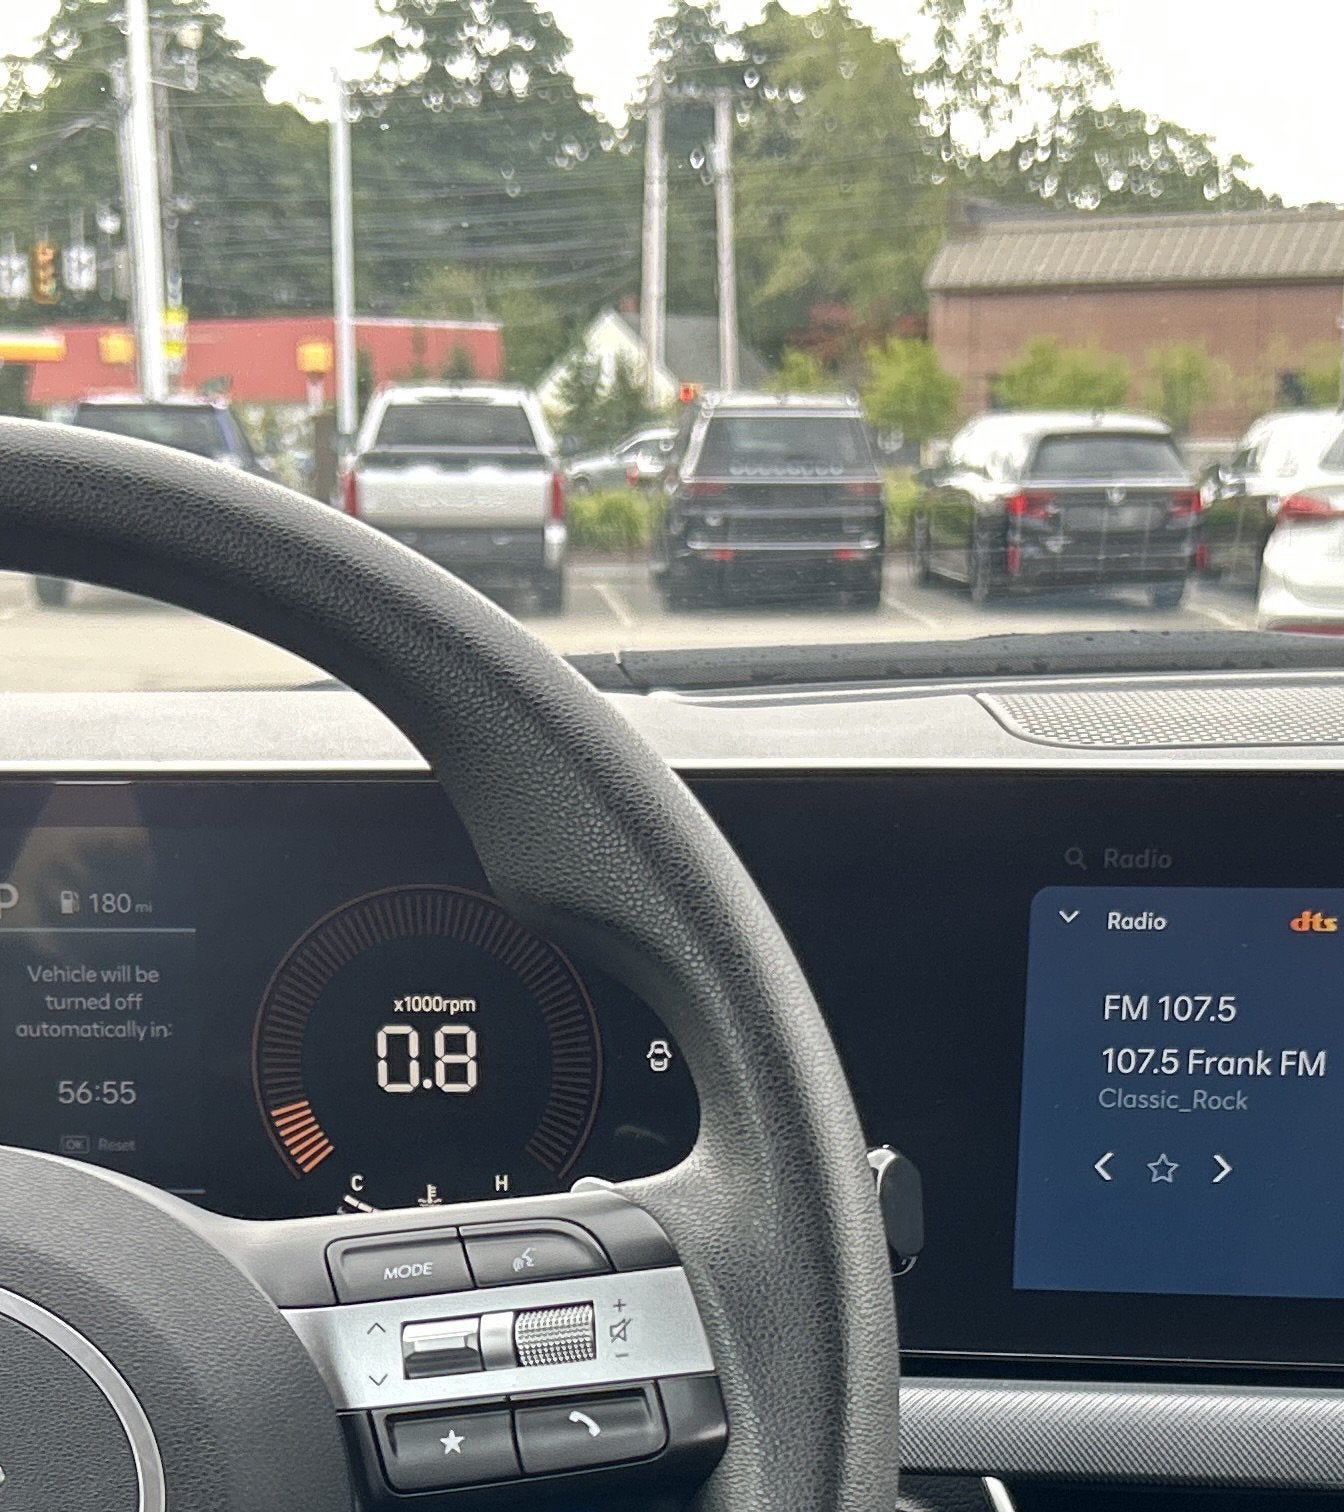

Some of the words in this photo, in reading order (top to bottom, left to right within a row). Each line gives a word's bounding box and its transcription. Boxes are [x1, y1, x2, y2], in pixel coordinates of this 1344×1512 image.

[1103, 848, 1172, 870] Radio
[89, 893, 132, 913] 180
[135, 901, 152, 912] mi
[1107, 911, 1167, 931] Radio
[1289, 910, 1338, 932] dts
[27, 965, 97, 982] Vehicle
[101, 965, 131, 982] will
[135, 966, 159, 982] be
[45, 993, 110, 1010] turned
[114, 993, 143, 1010] off
[393, 996, 476, 1014] x1000rpm
[1104, 994, 1147, 1021] FM
[1157, 994, 1237, 1023] 107.5
[16, 1020, 147, 1041] automatically
[150, 1021, 172, 1038] in:
[377, 1024, 477, 1093] 0.8
[1102, 1047, 1179, 1076] 107.5
[1188, 1049, 1271, 1076] Frank
[1281, 1050, 1327, 1076] FM
[58, 1081, 136, 1104] 56:55
[1098, 1087, 1248, 1113] Classic_Rock
[351, 1175, 364, 1192] C
[495, 1174, 509, 1192] H
[383, 1262, 433, 1280] MODE
